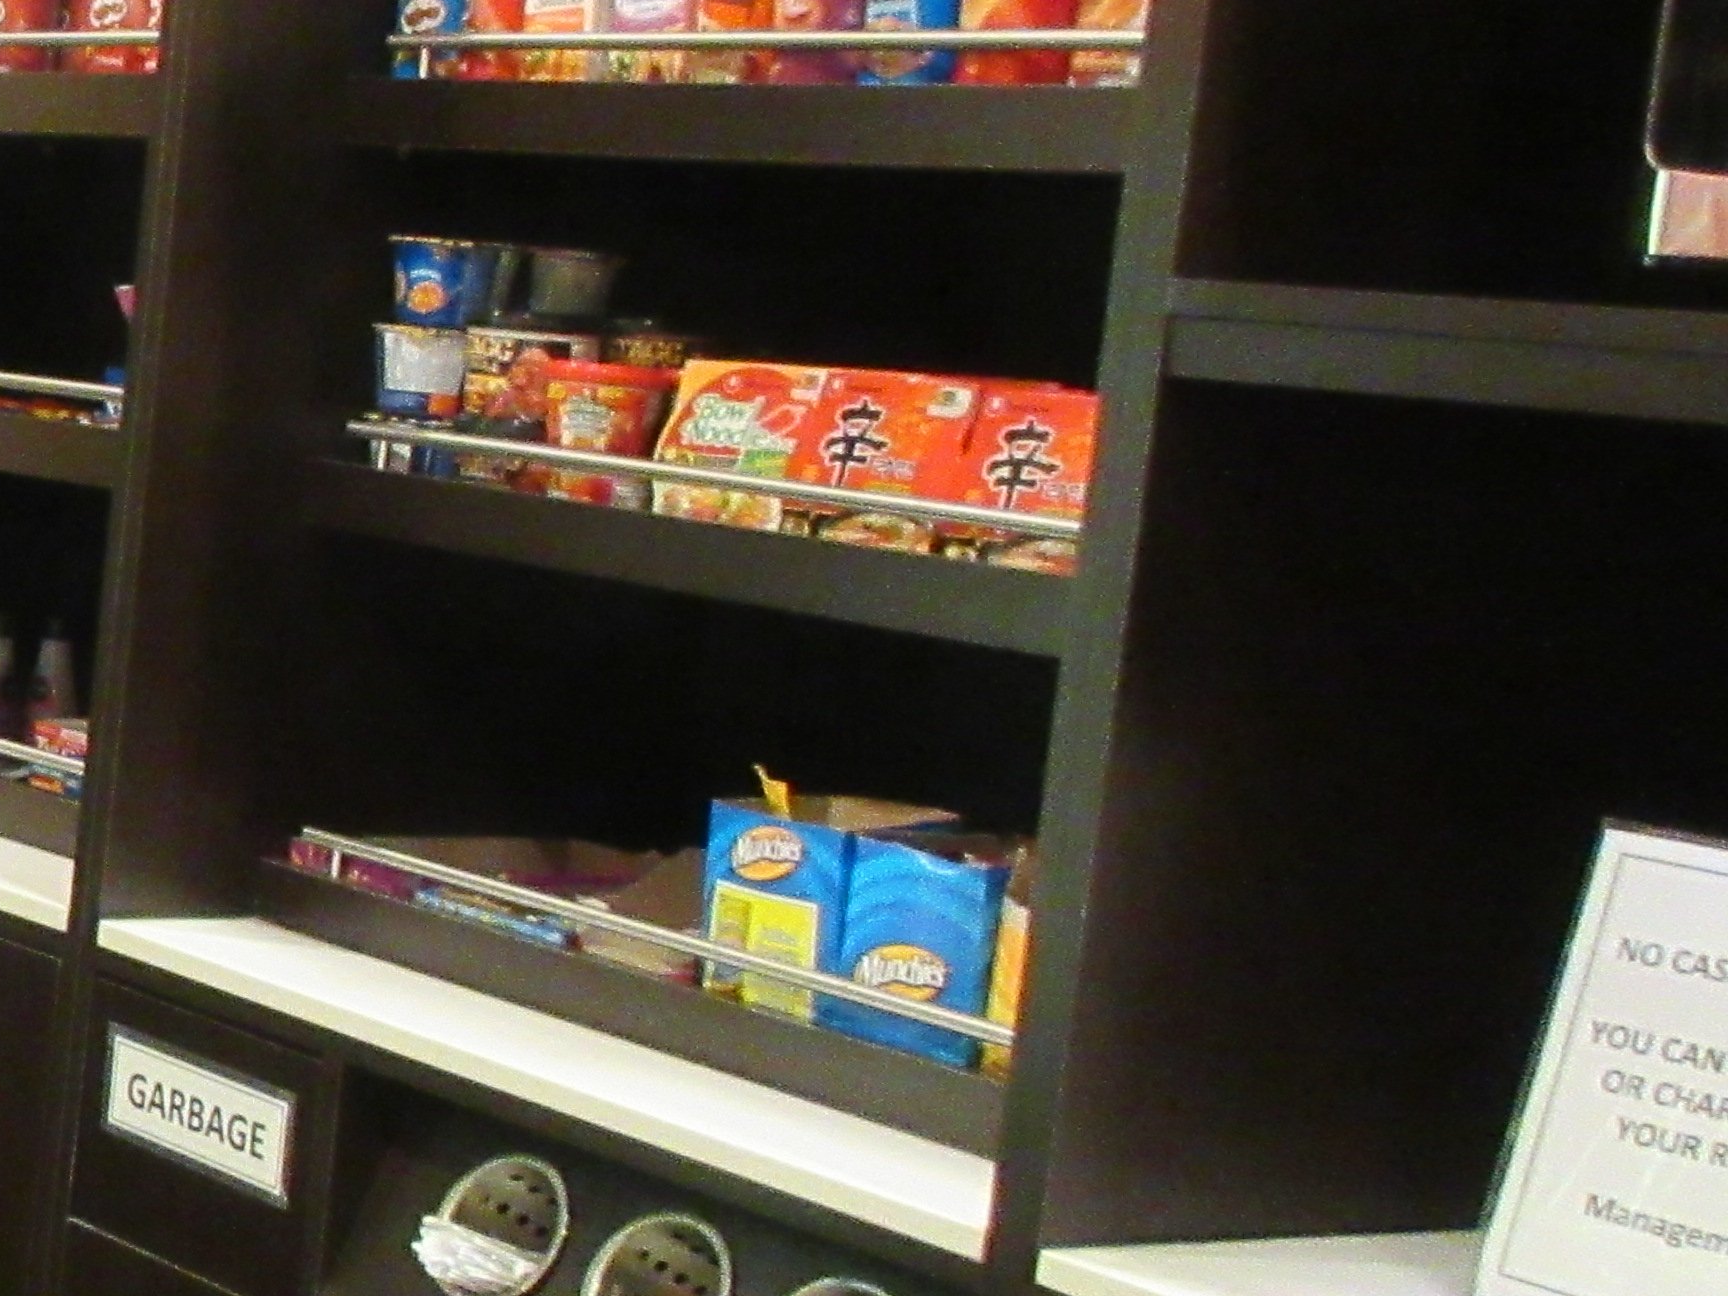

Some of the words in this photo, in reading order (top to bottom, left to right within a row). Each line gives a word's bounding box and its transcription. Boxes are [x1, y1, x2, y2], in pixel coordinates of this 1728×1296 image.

[1618, 937, 1664, 967] NO
[1591, 1020, 1655, 1055] YOU
[1661, 1038, 1726, 1072] CAN
[1601, 1069, 1644, 1099] OR
[127, 1073, 267, 1160] GARBAGE
[1617, 1116, 1701, 1161] YOUR
